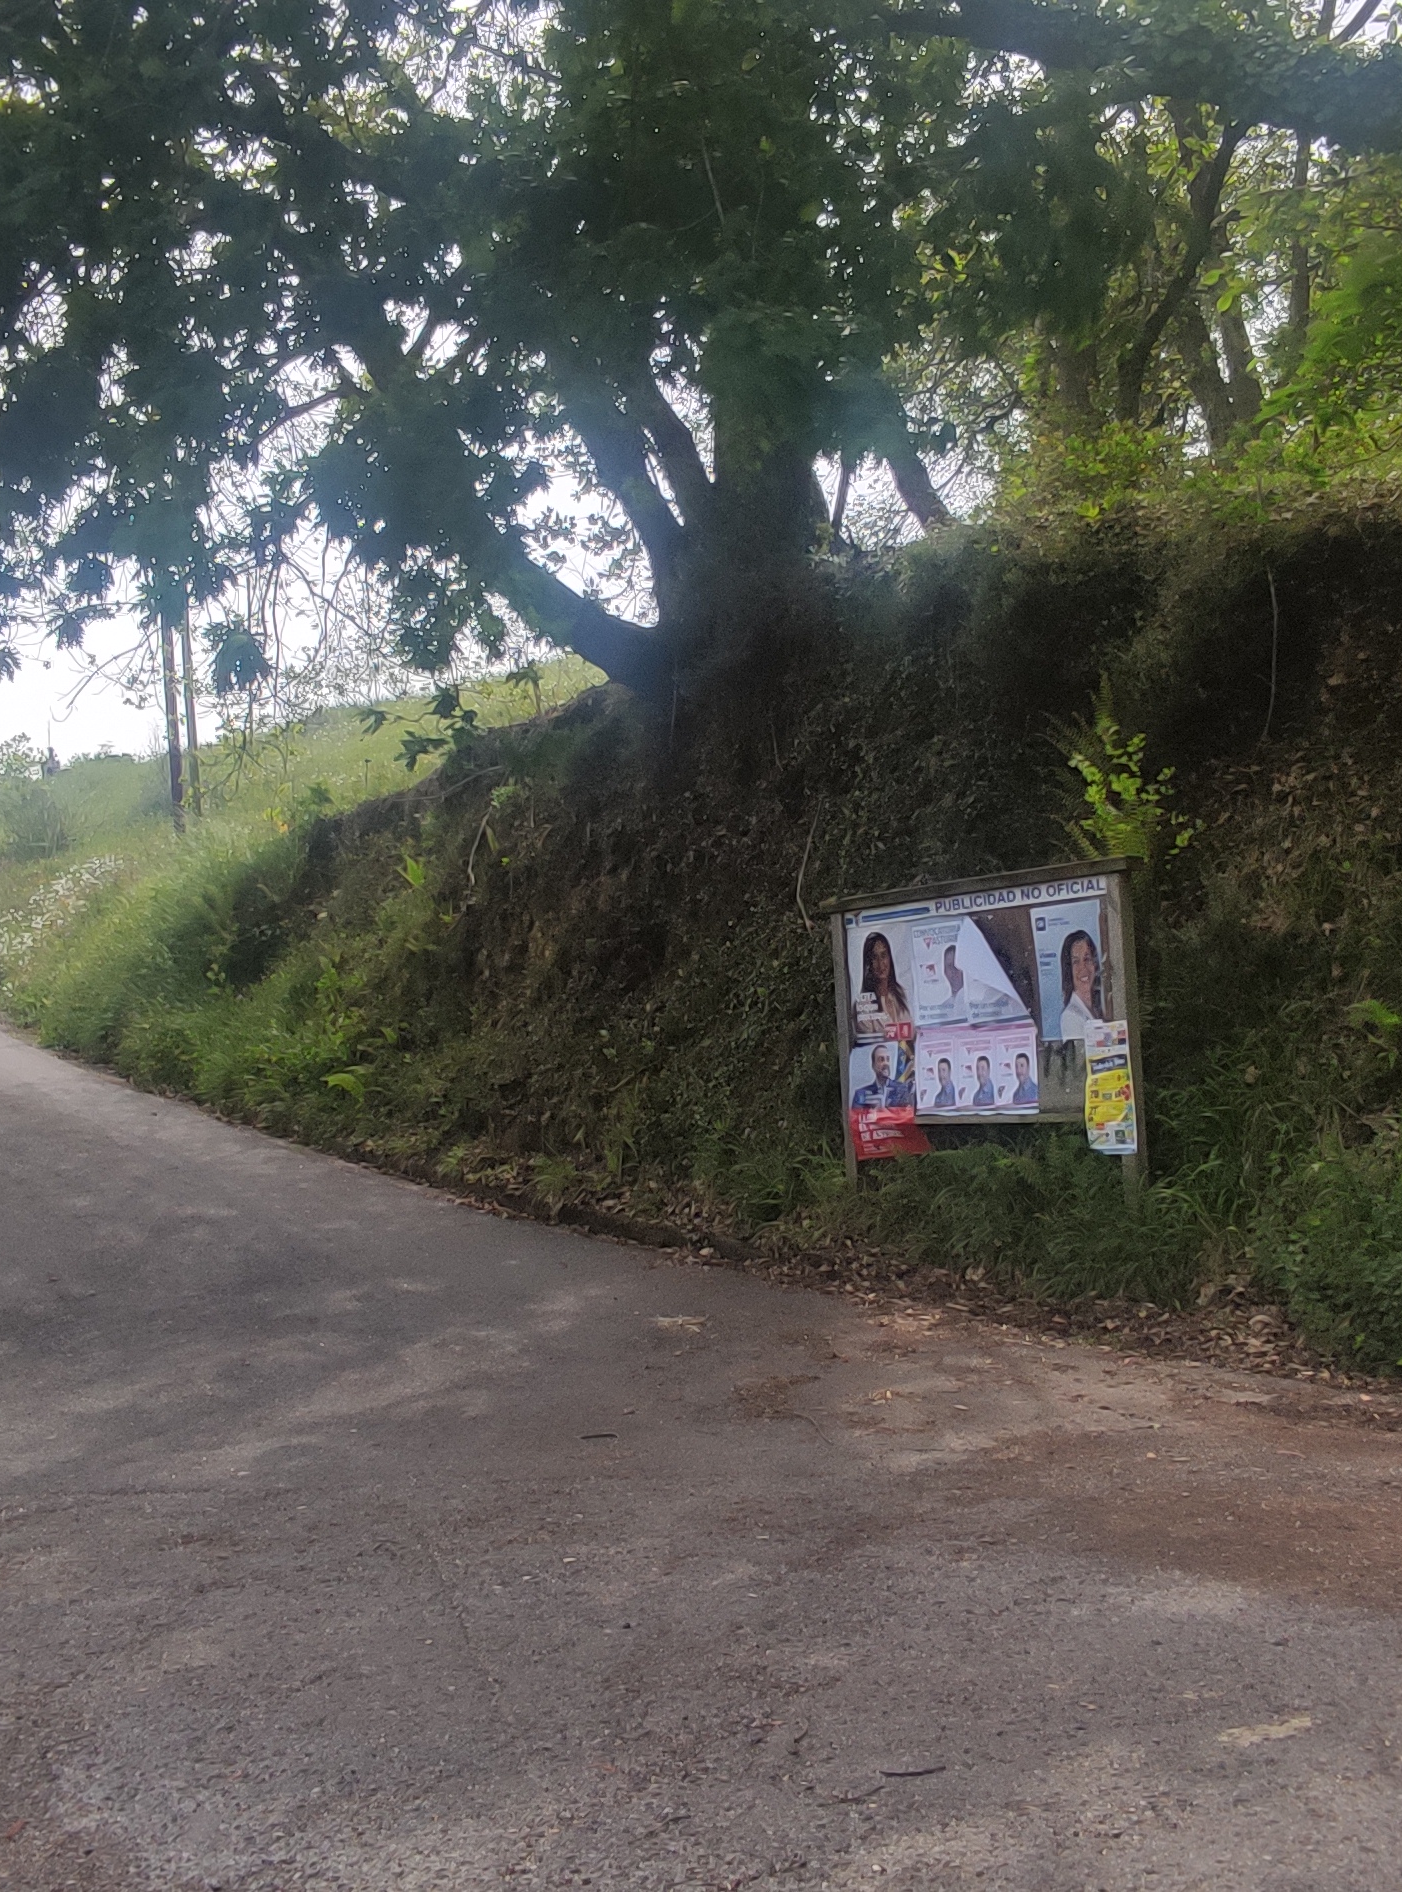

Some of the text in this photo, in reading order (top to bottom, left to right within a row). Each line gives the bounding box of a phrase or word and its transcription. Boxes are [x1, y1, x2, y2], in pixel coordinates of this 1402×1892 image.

[934, 878, 1106, 913] PUBLICIDAD NO OFICIAL
